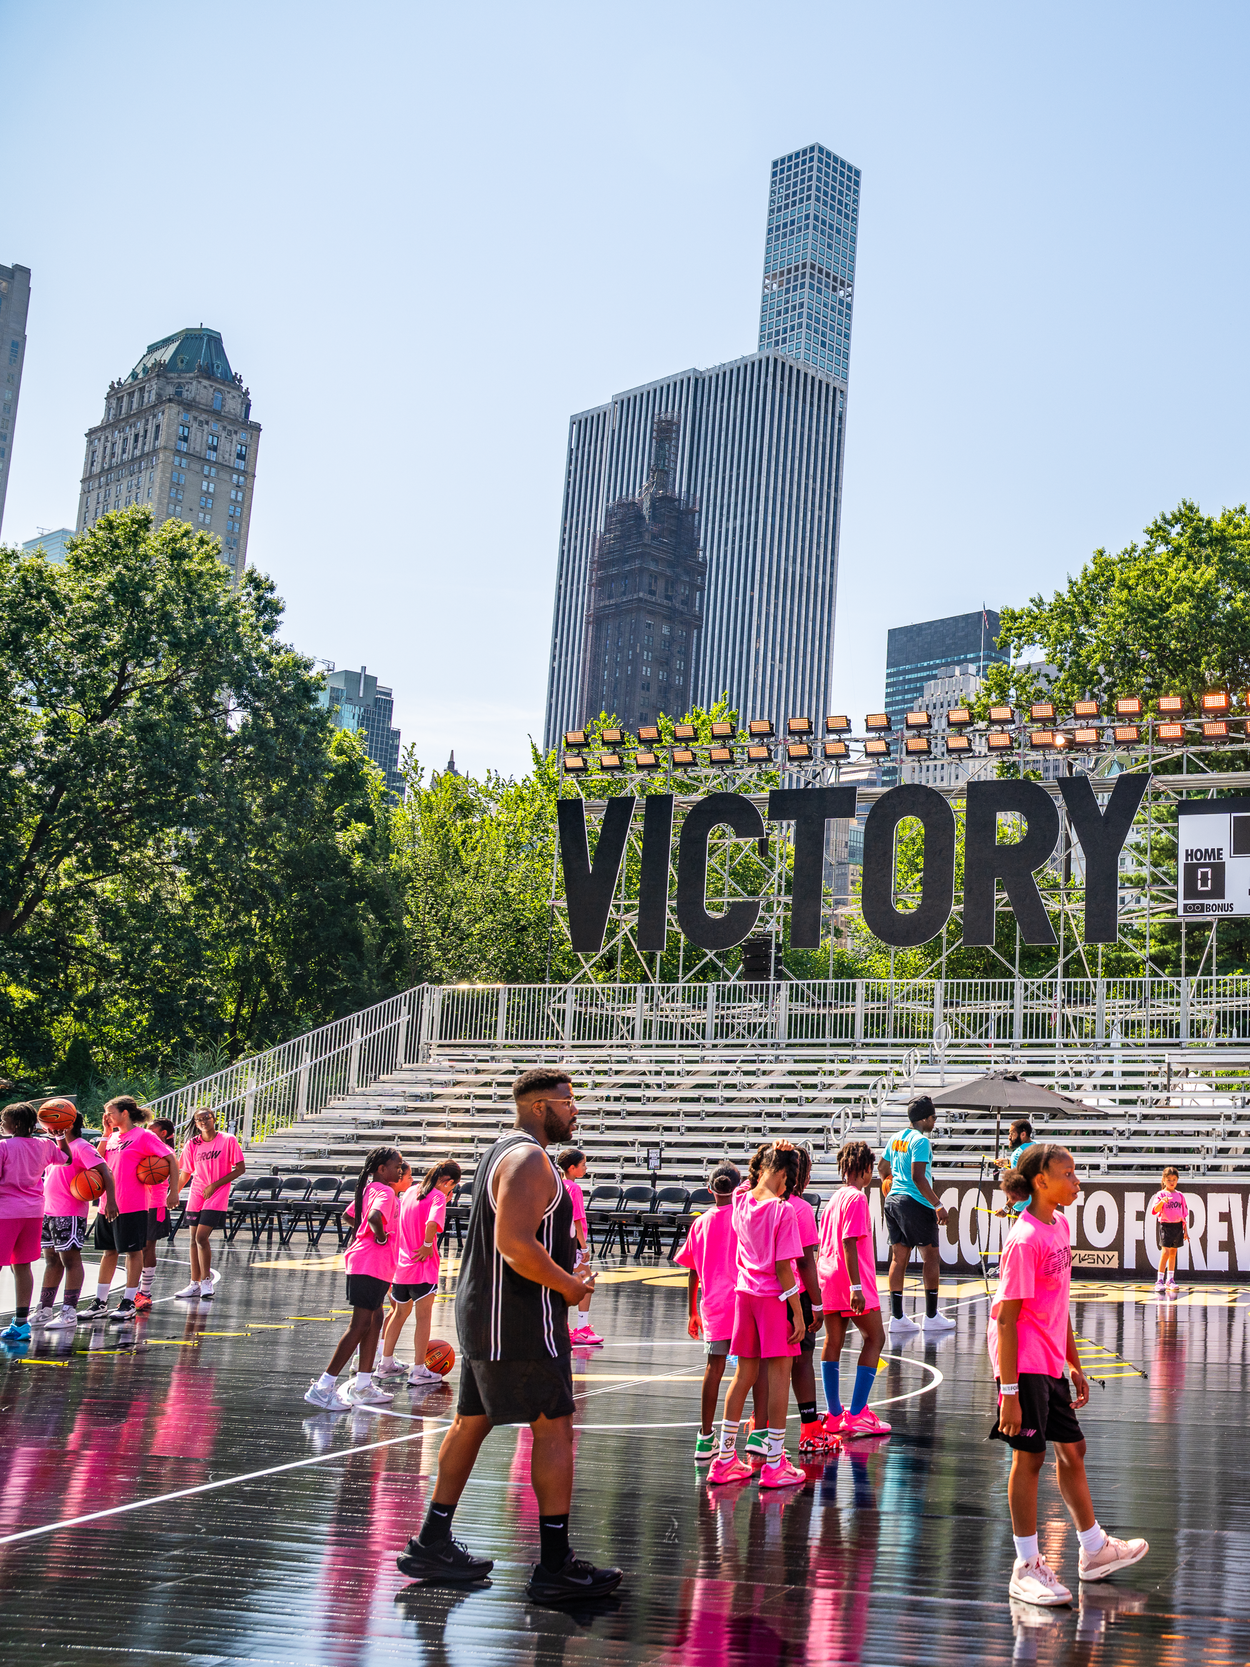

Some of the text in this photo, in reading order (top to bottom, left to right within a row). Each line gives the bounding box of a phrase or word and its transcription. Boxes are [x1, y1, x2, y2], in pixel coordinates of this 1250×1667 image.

[557, 773, 1152, 953] VICTORY
[1185, 848, 1224, 862] HOME
[1197, 867, 1212, 891] 0
[1205, 902, 1234, 913] BONUS
[1064, 1190, 1119, 1248] TO
